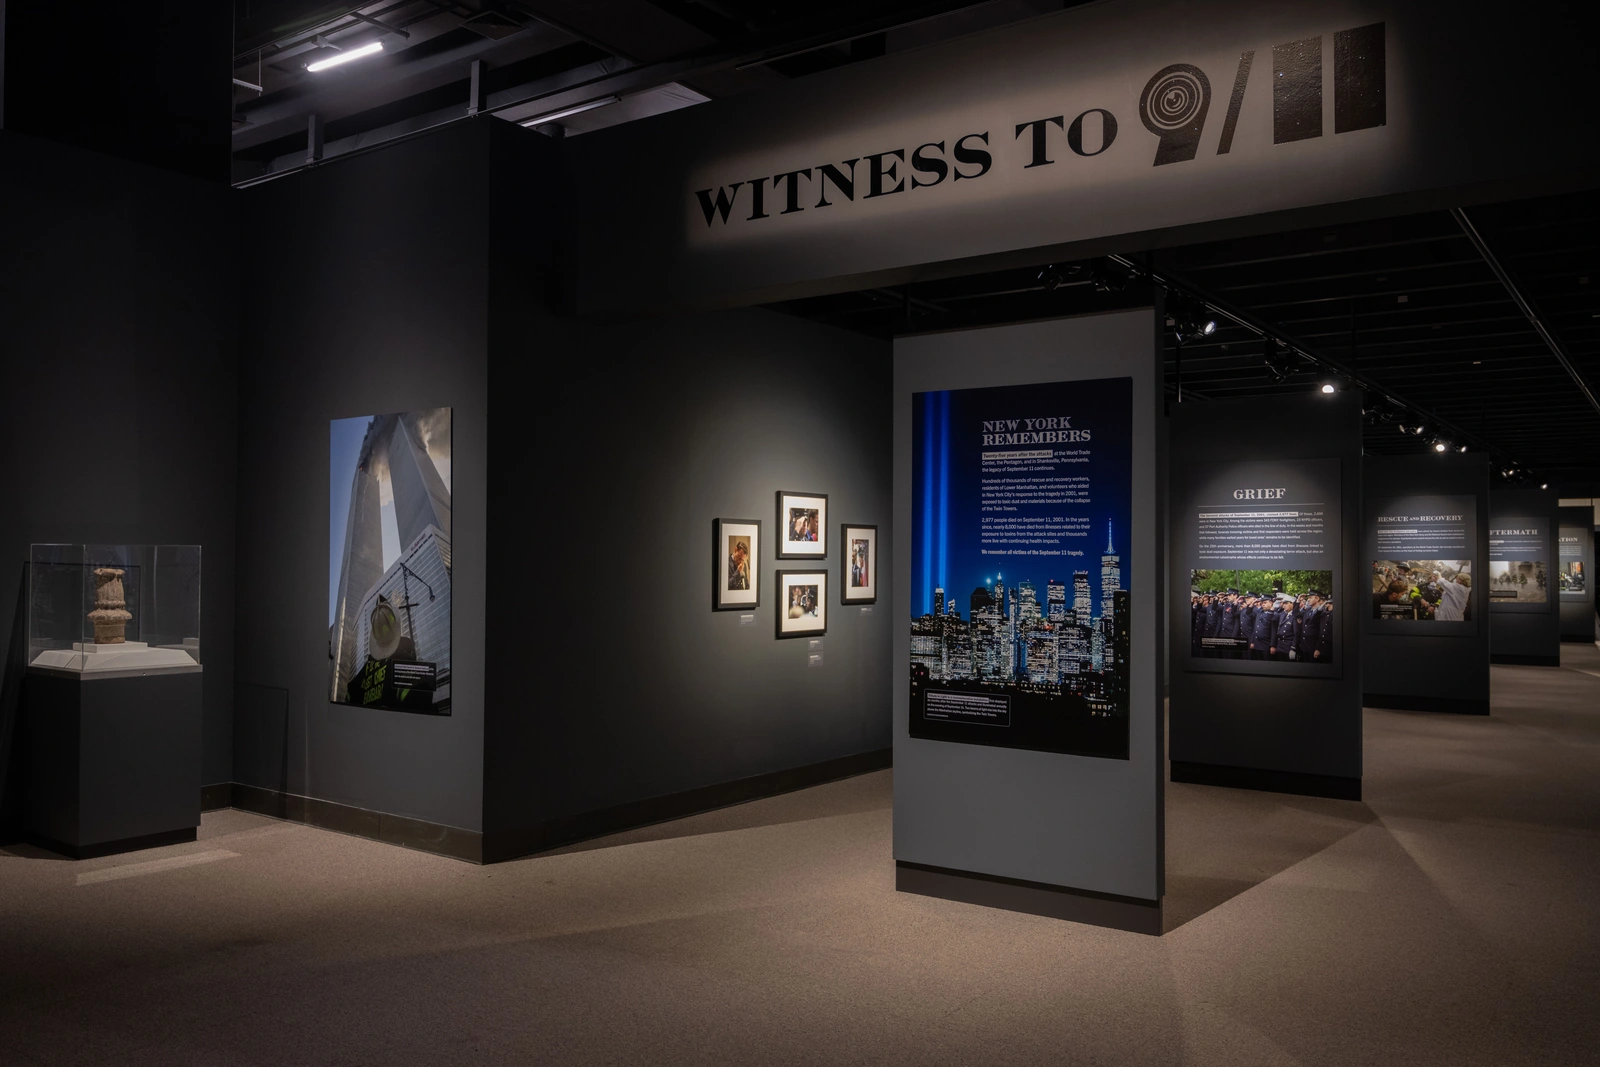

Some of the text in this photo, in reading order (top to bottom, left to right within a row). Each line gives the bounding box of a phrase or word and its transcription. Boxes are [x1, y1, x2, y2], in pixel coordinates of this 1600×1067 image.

[695, 21, 1386, 227] WITNESS TO 9/11
[982, 417, 1072, 432] NEW YORK
[982, 429, 1091, 446] REMEMBERS
[1233, 488, 1286, 500] GRIEF
